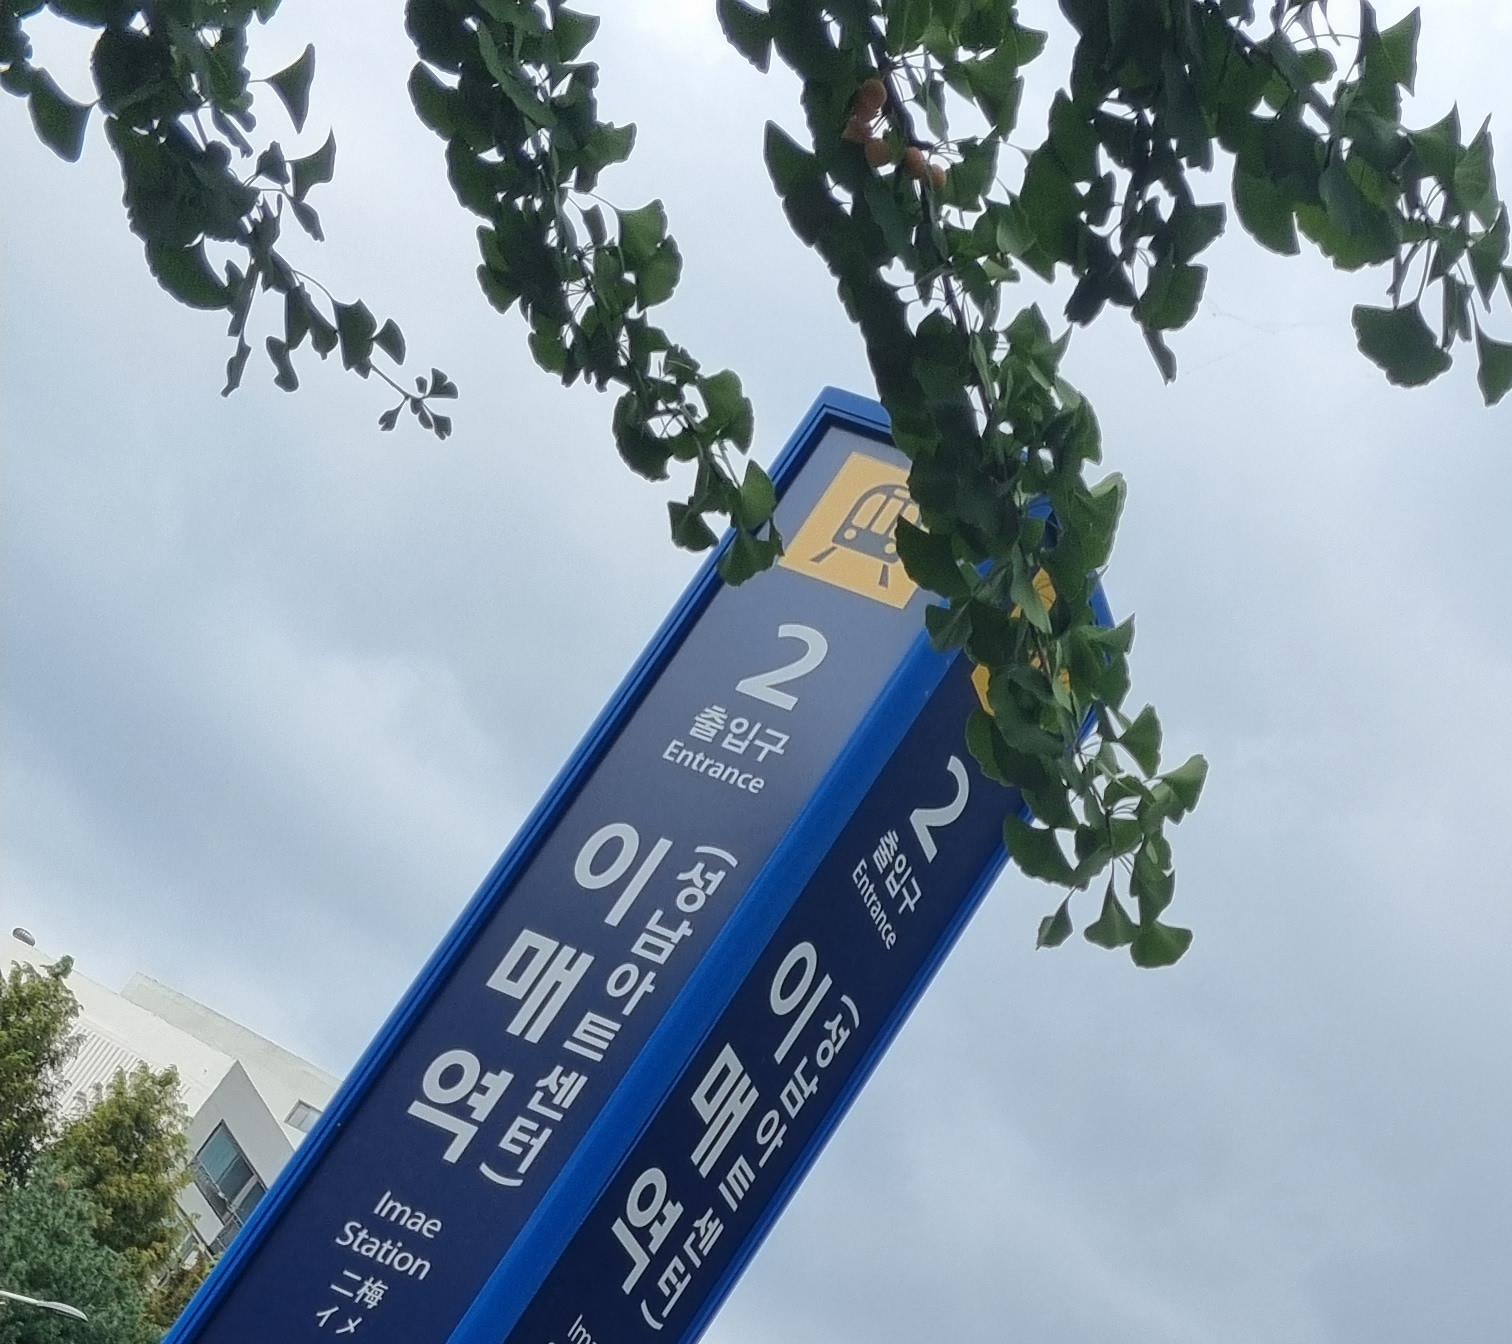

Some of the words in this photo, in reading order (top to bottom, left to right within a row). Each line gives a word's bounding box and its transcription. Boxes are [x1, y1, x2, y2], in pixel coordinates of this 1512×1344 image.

[735, 624, 828, 711] 2
[662, 739, 765, 794] Entrance
[689, 705, 792, 763] 출입구
[910, 756, 969, 862] 2
[852, 859, 898, 951] Entrance
[871, 829, 923, 917] 출입구
[407, 822, 673, 1164] 이매역
[479, 845, 738, 1187] (성남아트센터)
[610, 941, 832, 1294] 이매역
[640, 994, 860, 1331] (성남아트센터)
[335, 1221, 431, 1281] Station
[373, 1191, 442, 1239] Imae
[315, 1306, 361, 1335] イメ
[330, 1269, 388, 1309] 二梅
